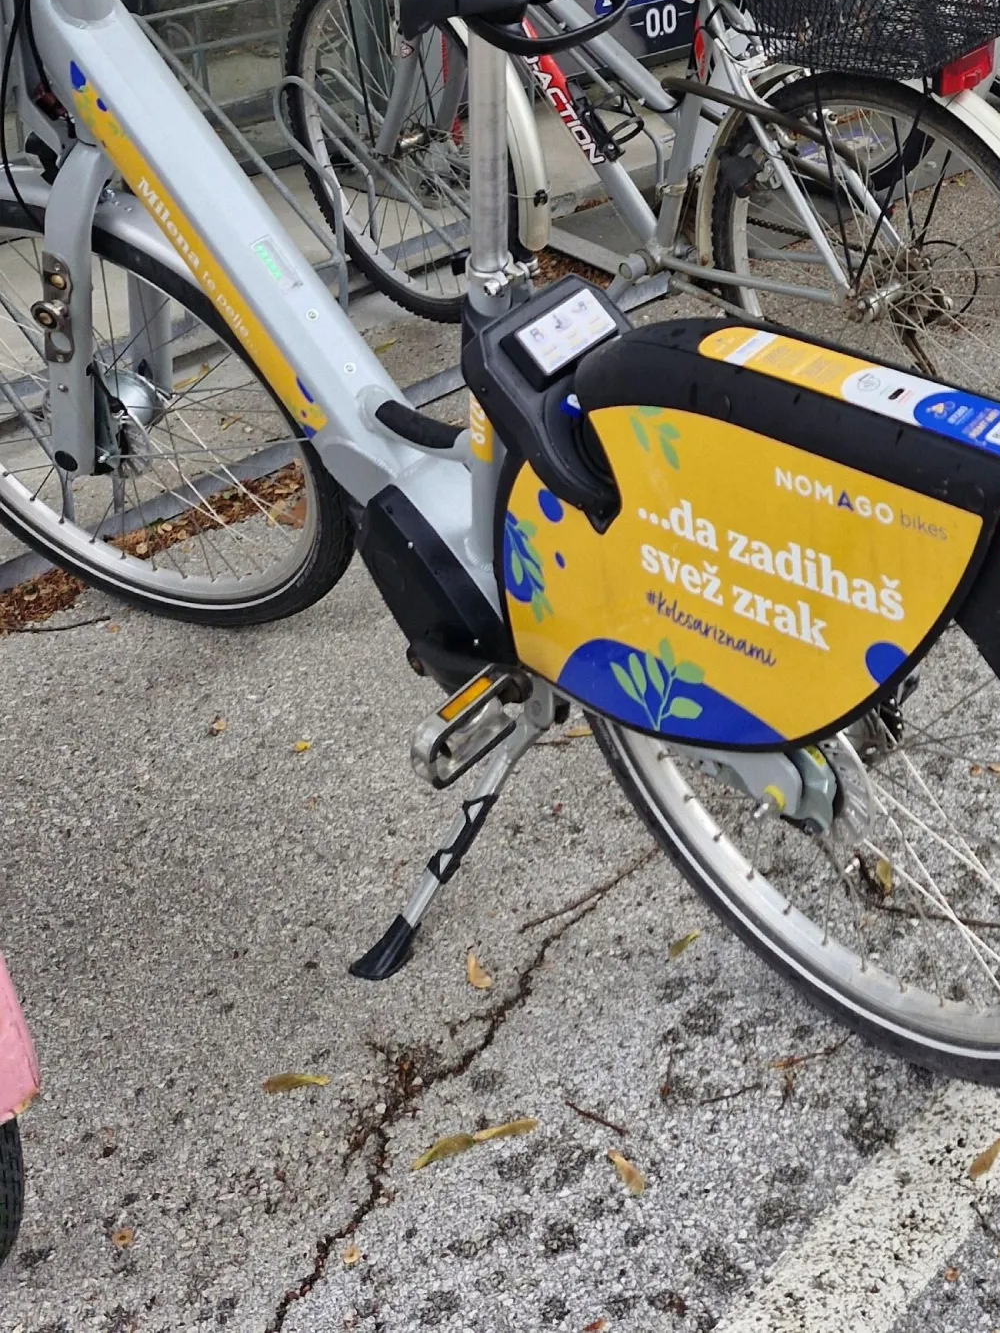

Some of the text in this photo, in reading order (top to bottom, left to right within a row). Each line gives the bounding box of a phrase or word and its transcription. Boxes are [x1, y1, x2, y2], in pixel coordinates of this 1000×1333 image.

[138, 176, 200, 271] Milena
[202, 271, 216, 291] te
[775, 466, 948, 541] NOMAGO bikes
[638, 499, 905, 621] ...da zadihaš
[640, 544, 830, 652] svež zrak
[646, 589, 777, 667] #kolesariznami
